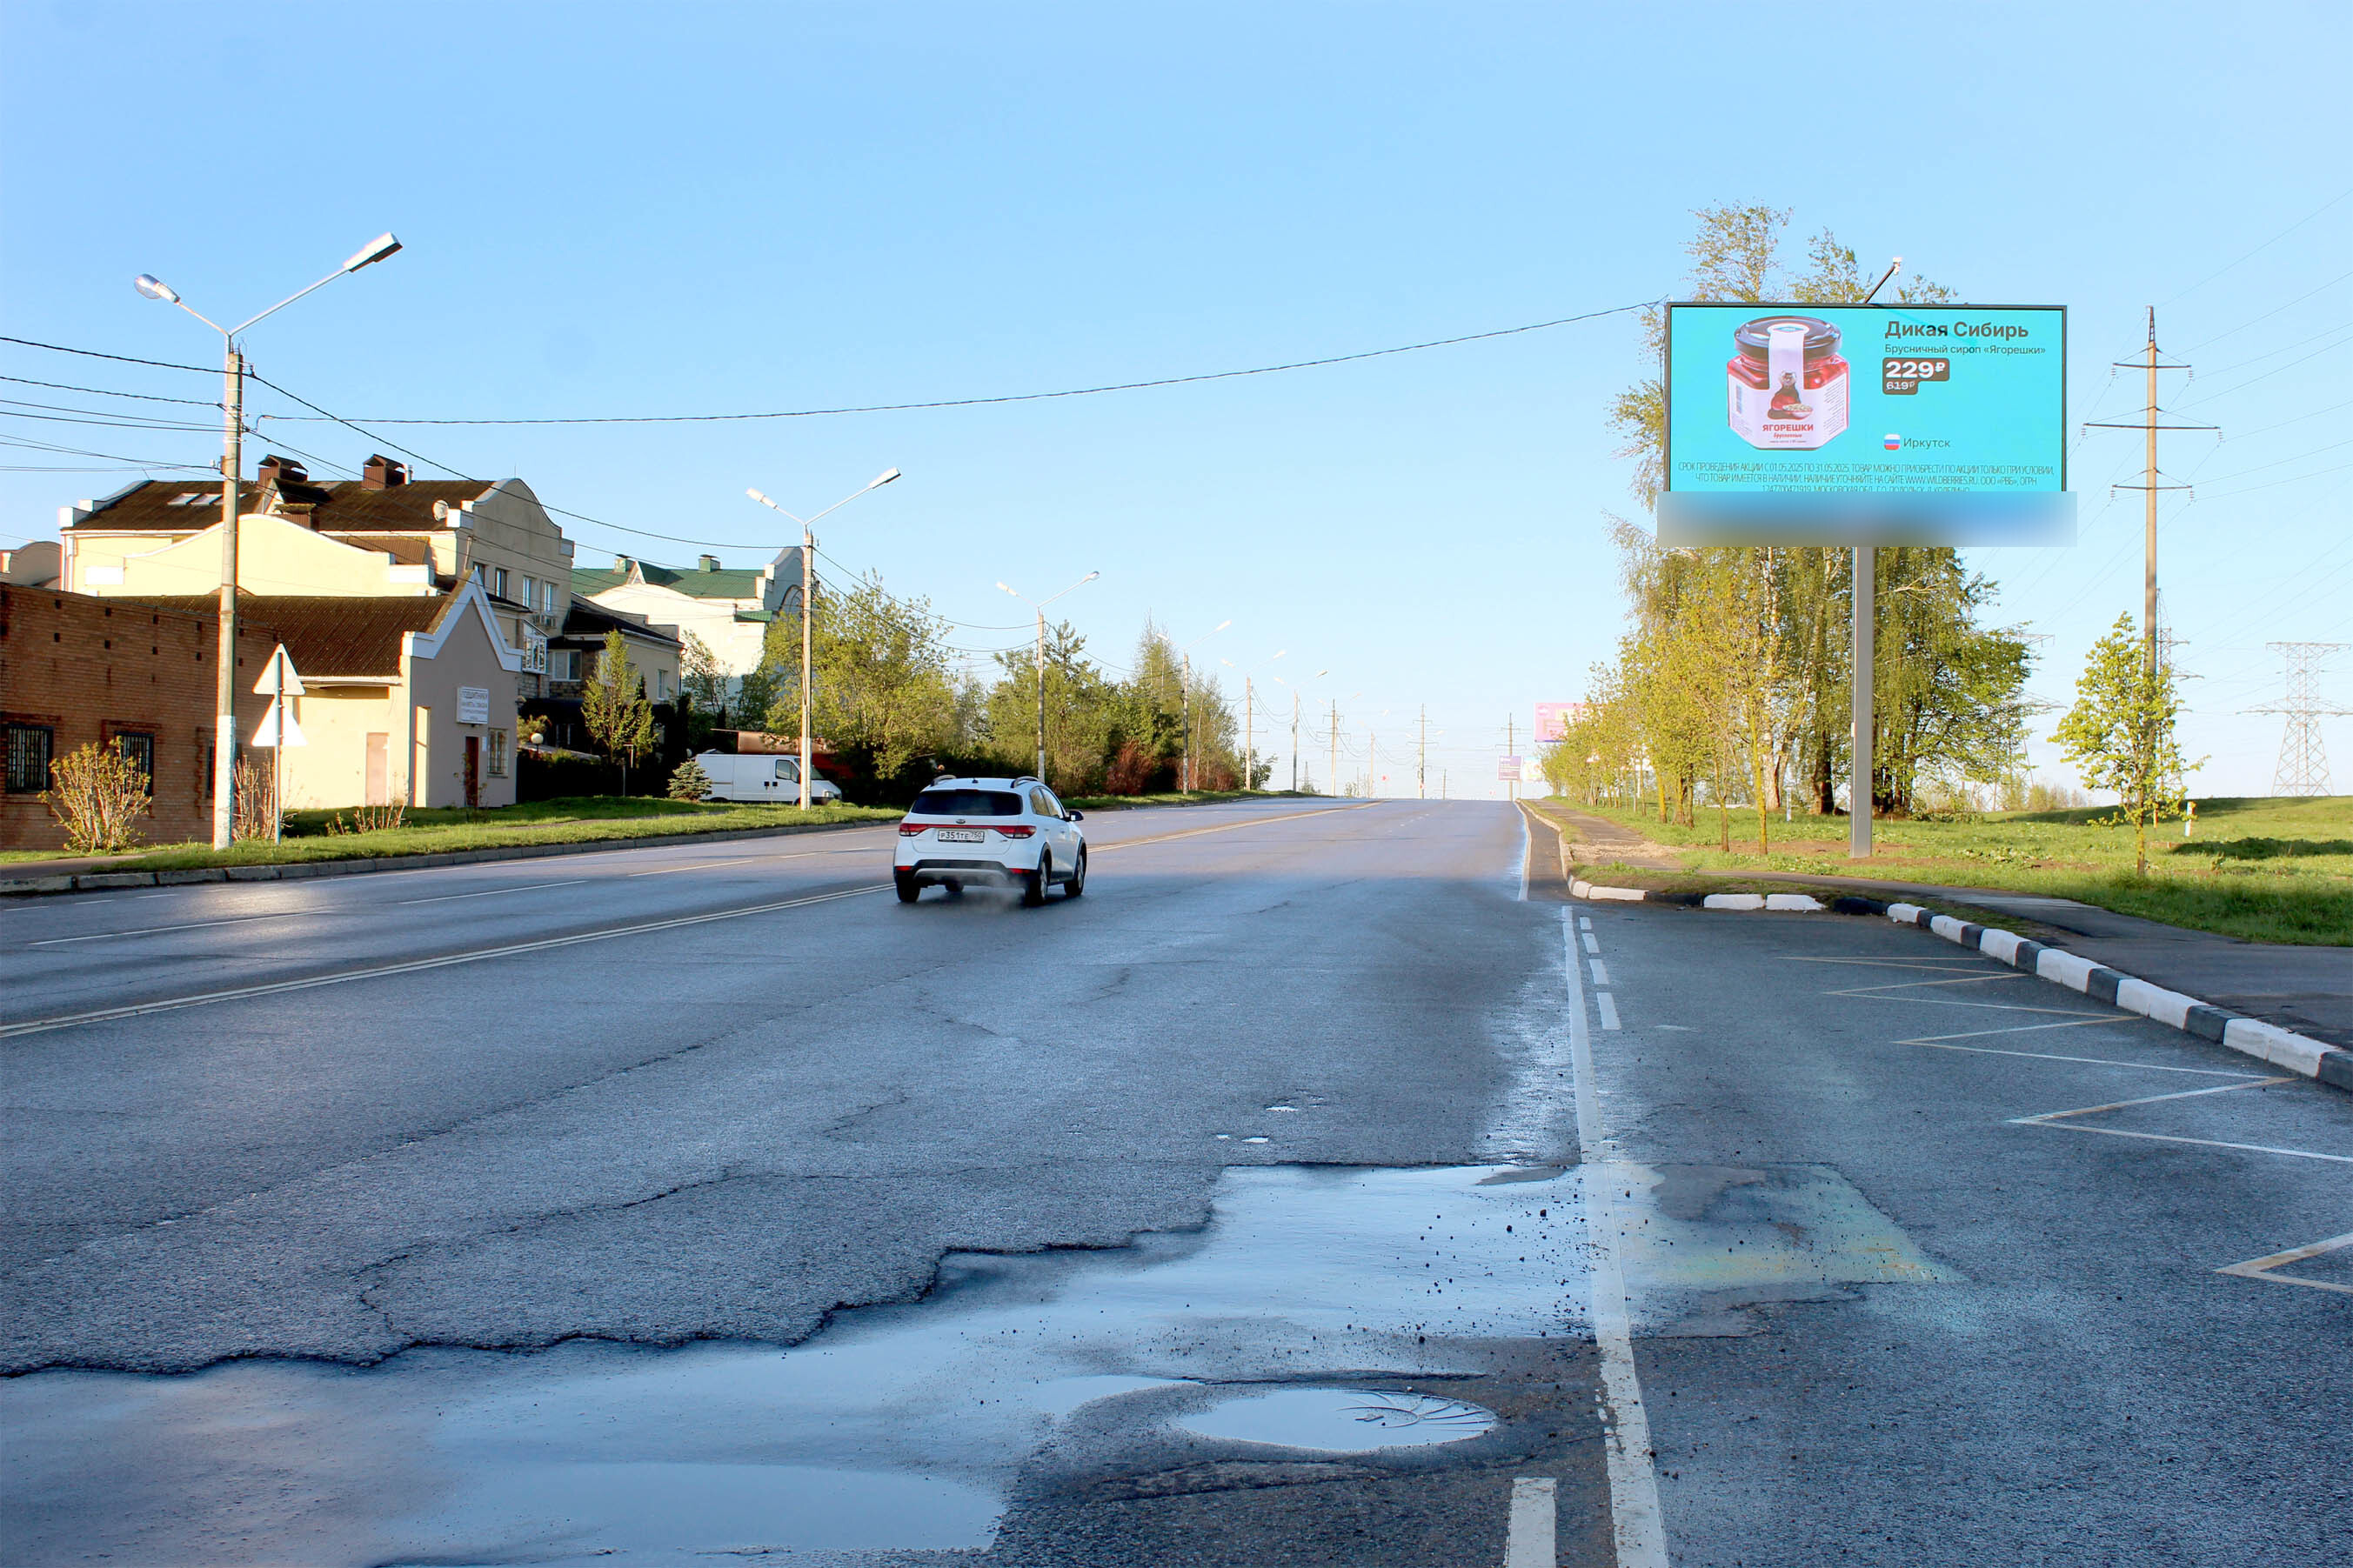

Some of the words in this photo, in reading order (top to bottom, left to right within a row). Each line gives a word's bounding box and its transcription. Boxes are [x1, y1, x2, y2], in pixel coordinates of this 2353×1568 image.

[1885, 321, 1948, 339] Дикая
[1954, 321, 2029, 341] Сибирь
[1885, 344, 1949, 356] Брусничный
[1950, 346, 1981, 356] сироп
[1984, 345, 2045, 356] «Ягорешки»
[1903, 437, 1950, 450] Иркутск
[1678, 462, 1695, 471] СРОК
[1696, 462, 1740, 471] ПРОВЕДЕНИЯ
[1741, 463, 1763, 472] АКЦИИ
[1804, 463, 1815, 472] ПО
[1852, 464, 1872, 472] ТОВАР
[1874, 464, 1900, 473] МОЖНО
[1902, 464, 1943, 474] ПРИОБРЕСТИ
[1945, 464, 1955, 474] ПО
[1956, 465, 1979, 475] АКЦИИ
[1979, 465, 2005, 474] ТОЛЬКО
[2007, 465, 2021, 474] ПРИ
[1695, 473, 1708, 482] ЧТО
[1709, 473, 1730, 482] ТОВАР
[1732, 473, 1761, 483] ИМЕЕТСЯ
[1804, 474, 1835, 484] НАЛИЧИЕ
[1835, 473, 1873, 484] УТОЧНЯЙТЕ
[1875, 475, 1883, 484] НА
[1884, 473, 1904, 484] САЙТЕ
[1980, 477, 1996, 485] ООО
[2020, 477, 2037, 486] ОГРН
